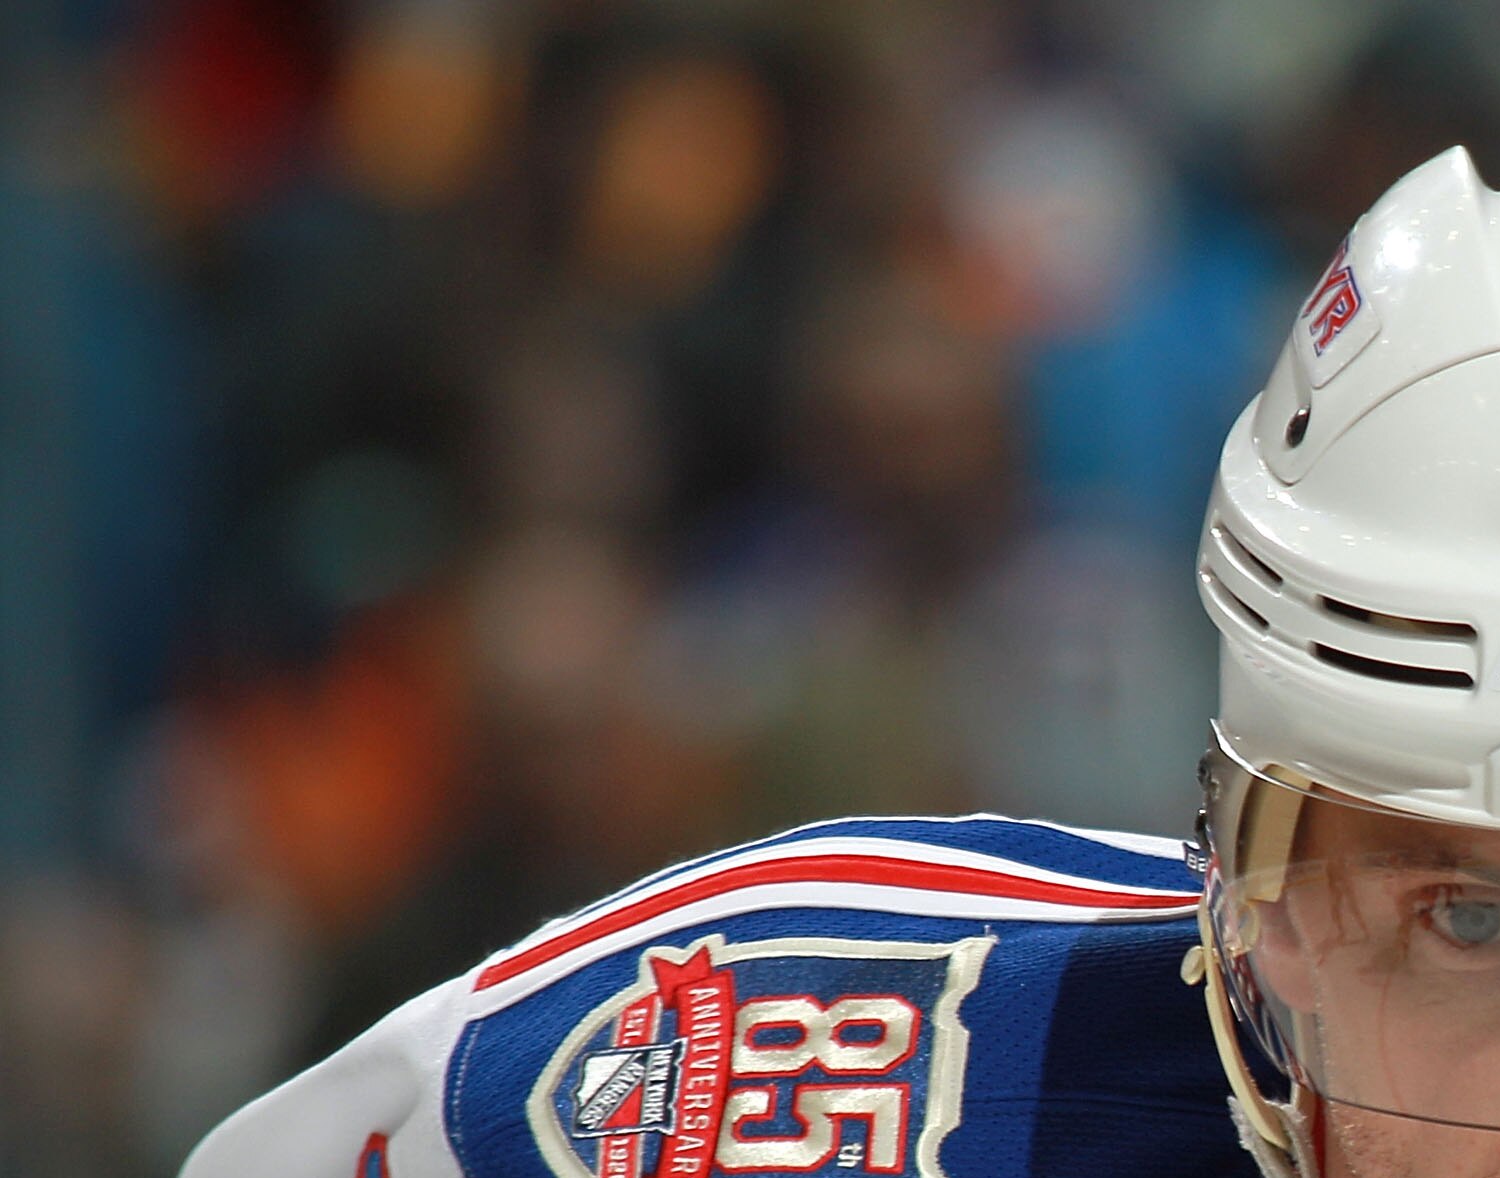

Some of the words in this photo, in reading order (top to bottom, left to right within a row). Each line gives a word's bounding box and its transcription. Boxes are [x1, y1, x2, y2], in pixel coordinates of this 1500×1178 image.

[650, 1049, 673, 1081] NEW
[582, 1061, 645, 1130] RANGERS
[643, 1082, 667, 1124] YORK
